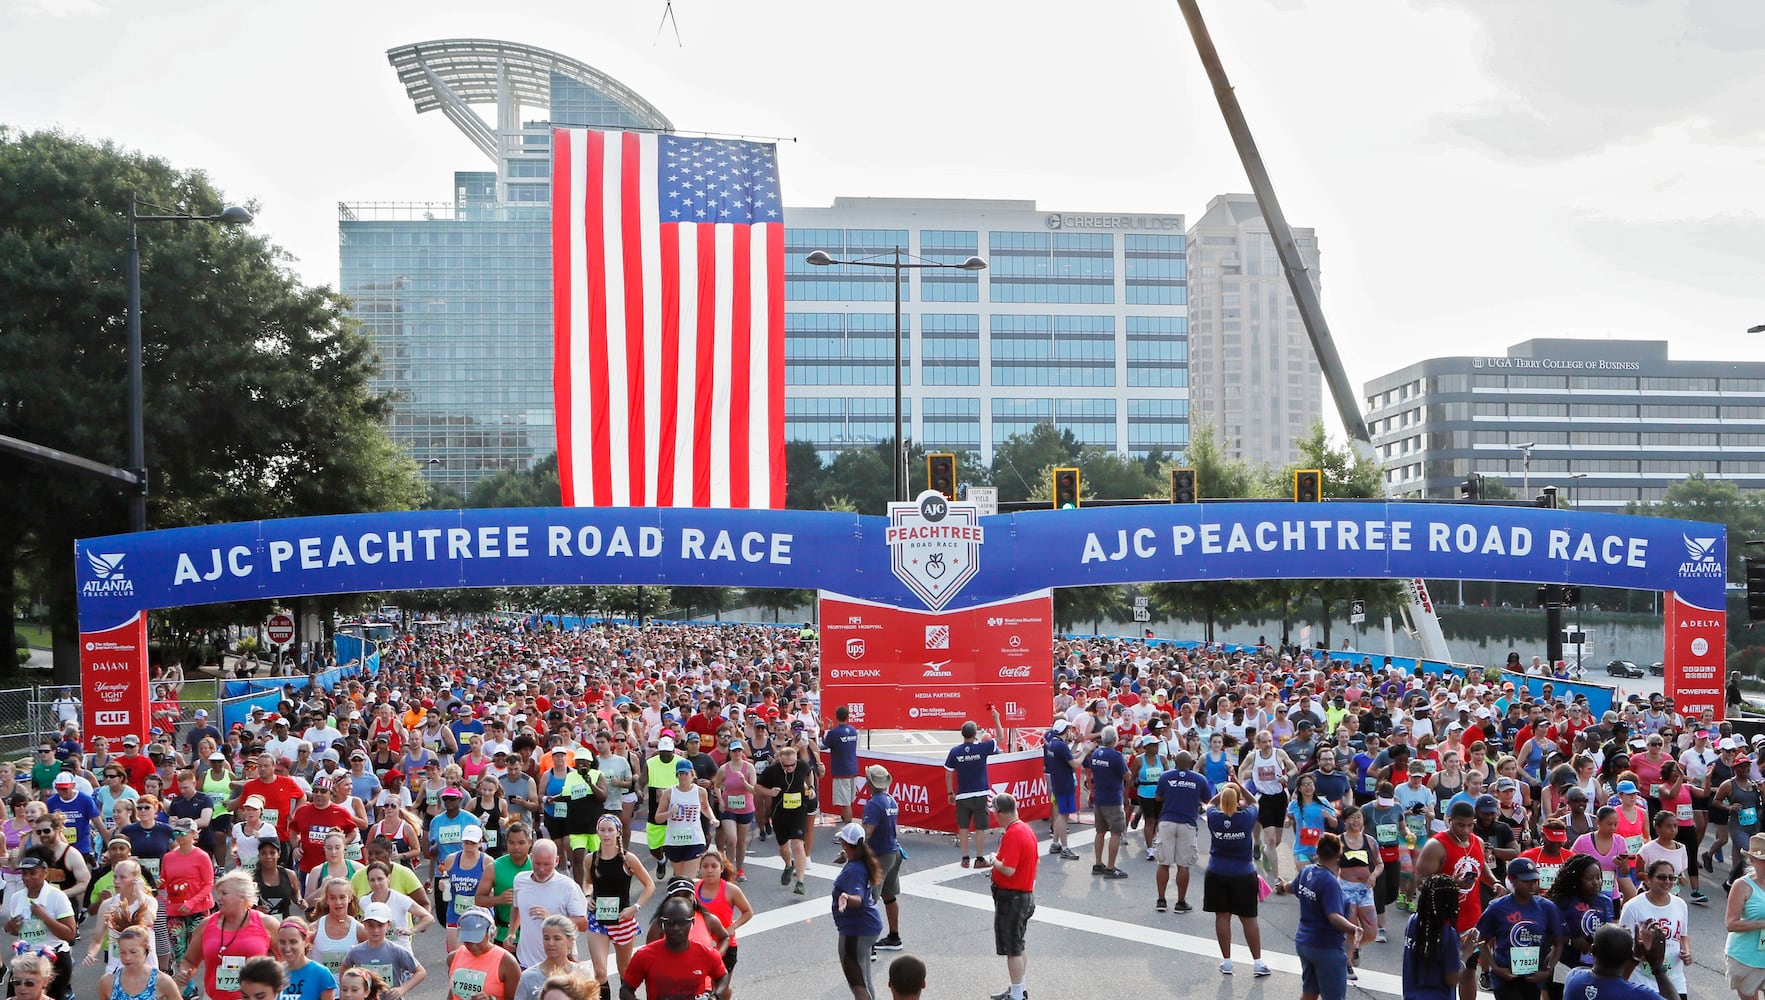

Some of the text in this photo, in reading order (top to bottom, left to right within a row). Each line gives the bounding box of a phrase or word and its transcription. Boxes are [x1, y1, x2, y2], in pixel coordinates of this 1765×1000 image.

[1064, 216, 1181, 230] CAREERBUILDER
[1488, 358, 1512, 367] UGA
[924, 504, 944, 515] AJC
[888, 526, 981, 542] PEACHTREE
[1080, 520, 1648, 568] AJC PEACHTREE ROAD RACE
[174, 526, 793, 586] AJC PEACHTREE ROAD RACE
[1678, 562, 1722, 573] ATLANTA
[82, 580, 133, 591] ATLANTA
[1136, 610, 1146, 619] 141
[848, 645, 863, 656] ups
[93, 662, 128, 672] DASANI
[100, 714, 126, 722] CLIF
[893, 782, 928, 804] ANTA
[1012, 778, 1048, 800] ATLAN
[904, 803, 929, 814] CLUB
[1016, 798, 1036, 809] RACK
[460, 982, 482, 992] 78850
